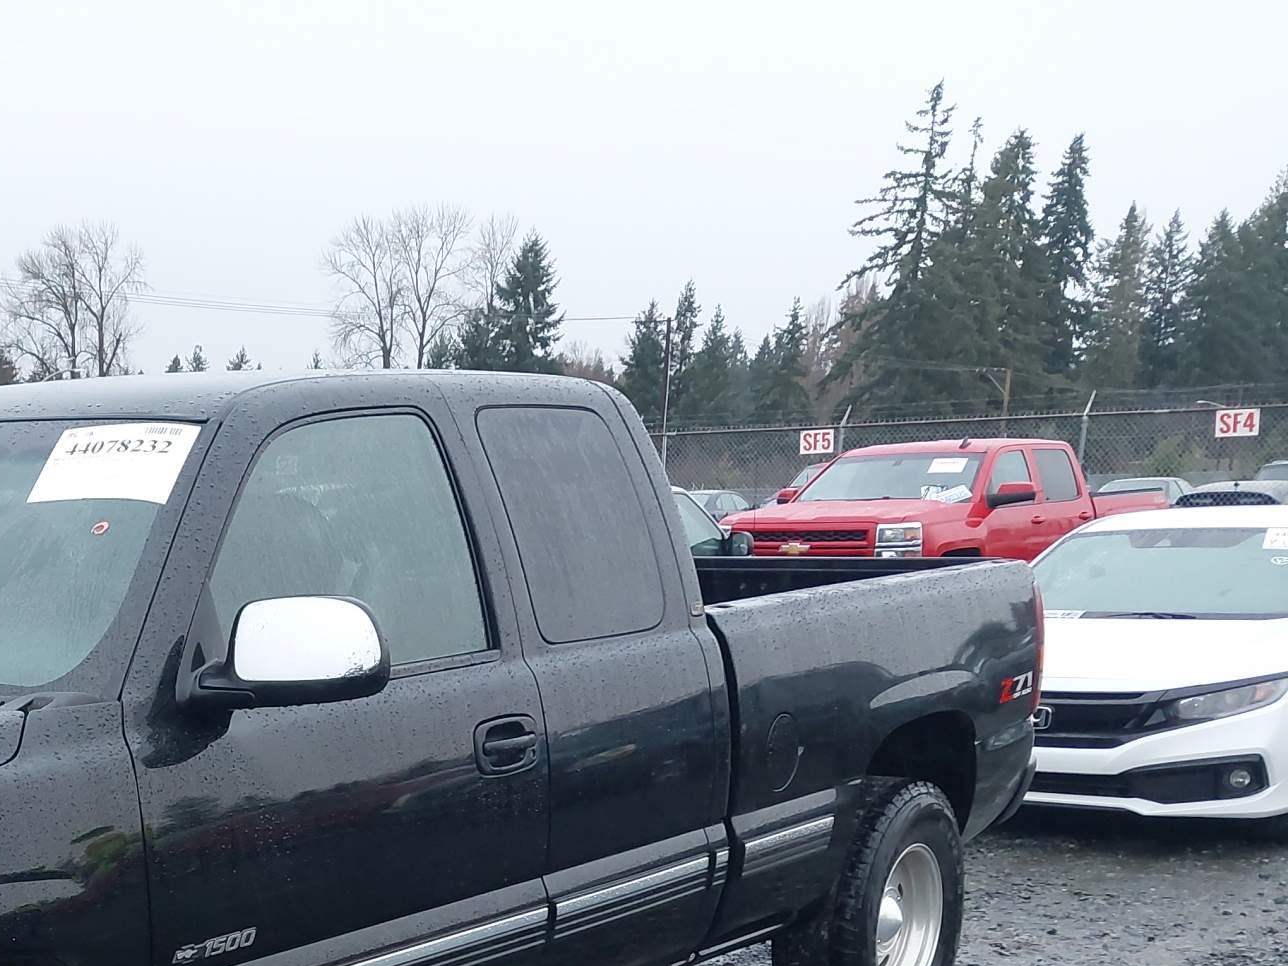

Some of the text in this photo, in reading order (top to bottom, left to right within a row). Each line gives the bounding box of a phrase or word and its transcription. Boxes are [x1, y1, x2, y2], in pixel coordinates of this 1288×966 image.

[1219, 412, 1256, 434] SF4
[65, 438, 173, 456] 44078232
[802, 432, 831, 451] SF5
[999, 670, 1033, 704] Z71
[204, 926, 257, 958] 1500
